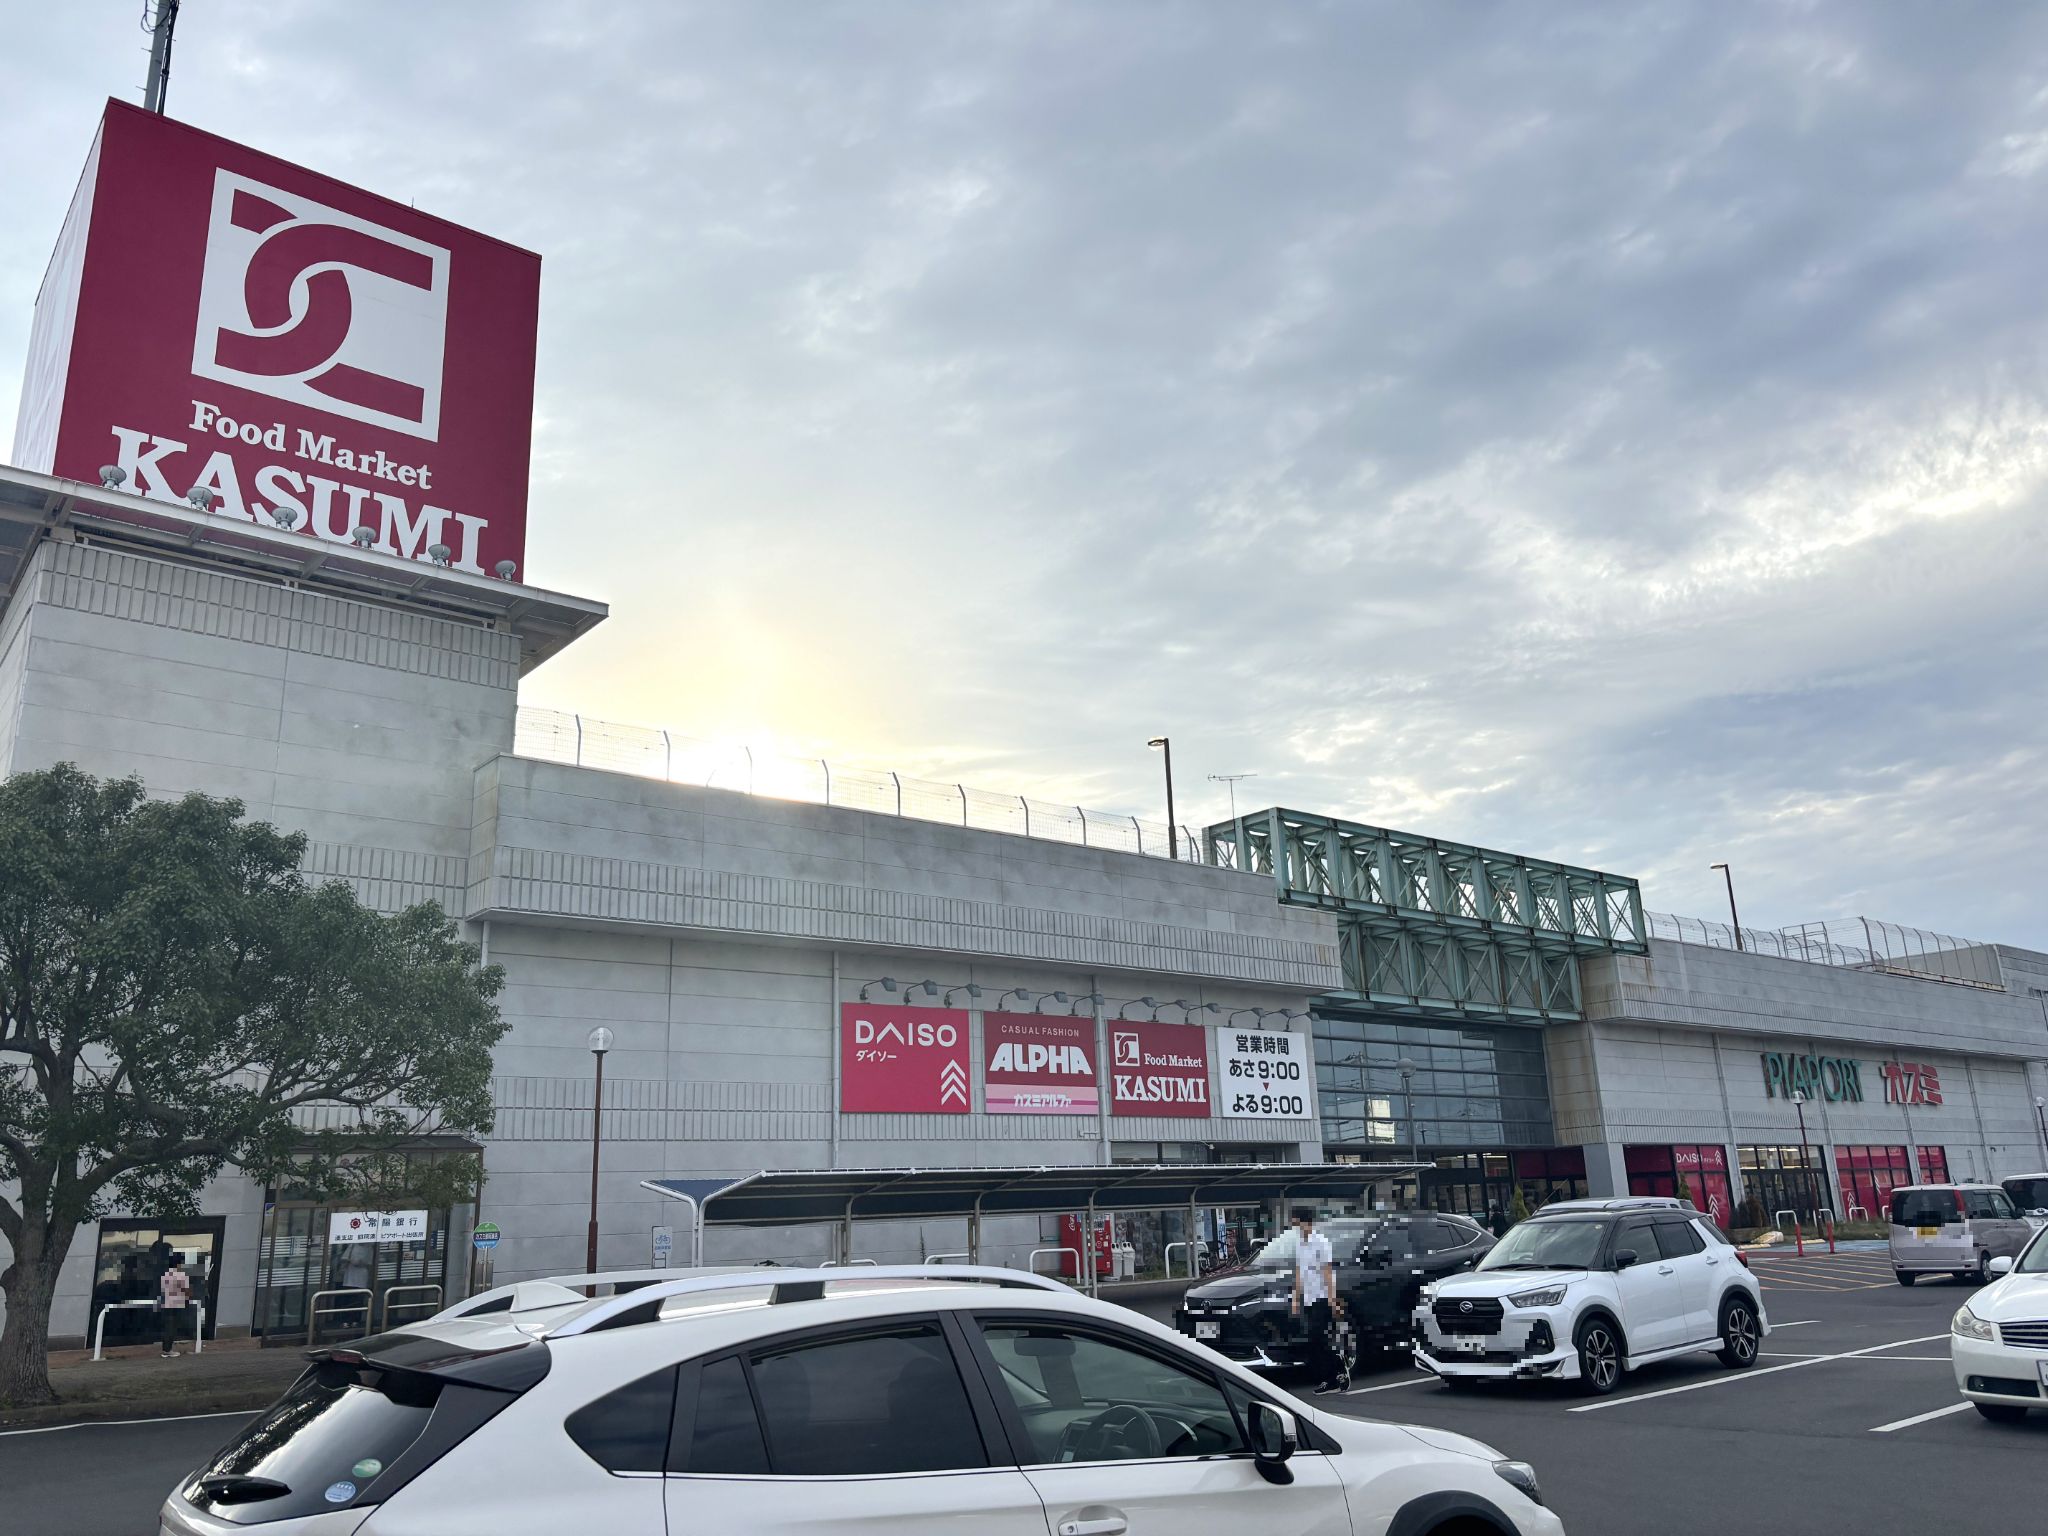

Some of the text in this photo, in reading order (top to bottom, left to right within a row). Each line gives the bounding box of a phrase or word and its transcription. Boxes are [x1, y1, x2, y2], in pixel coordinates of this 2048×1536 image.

[188, 400, 432, 490] Food Market
[111, 425, 489, 577] KASUMI
[855, 1020, 957, 1047] DAISO
[1001, 1025, 1079, 1037] CASUAL FASHION
[855, 1049, 897, 1062] ダイソー
[1236, 1034, 1290, 1056] 営業時間
[989, 1042, 1093, 1075] ALPHA
[1143, 1053, 1203, 1068] Food Market
[1229, 1058, 1300, 1081] あさ9:00
[1113, 1074, 1207, 1103] KASUMI
[1761, 1052, 1864, 1102] PIAPORT
[1880, 1062, 1943, 1105] カスミ
[1013, 1093, 1072, 1108] カスミアルファ
[1232, 1093, 1303, 1115] よる9:00
[1675, 1152, 1703, 1163] DAISO
